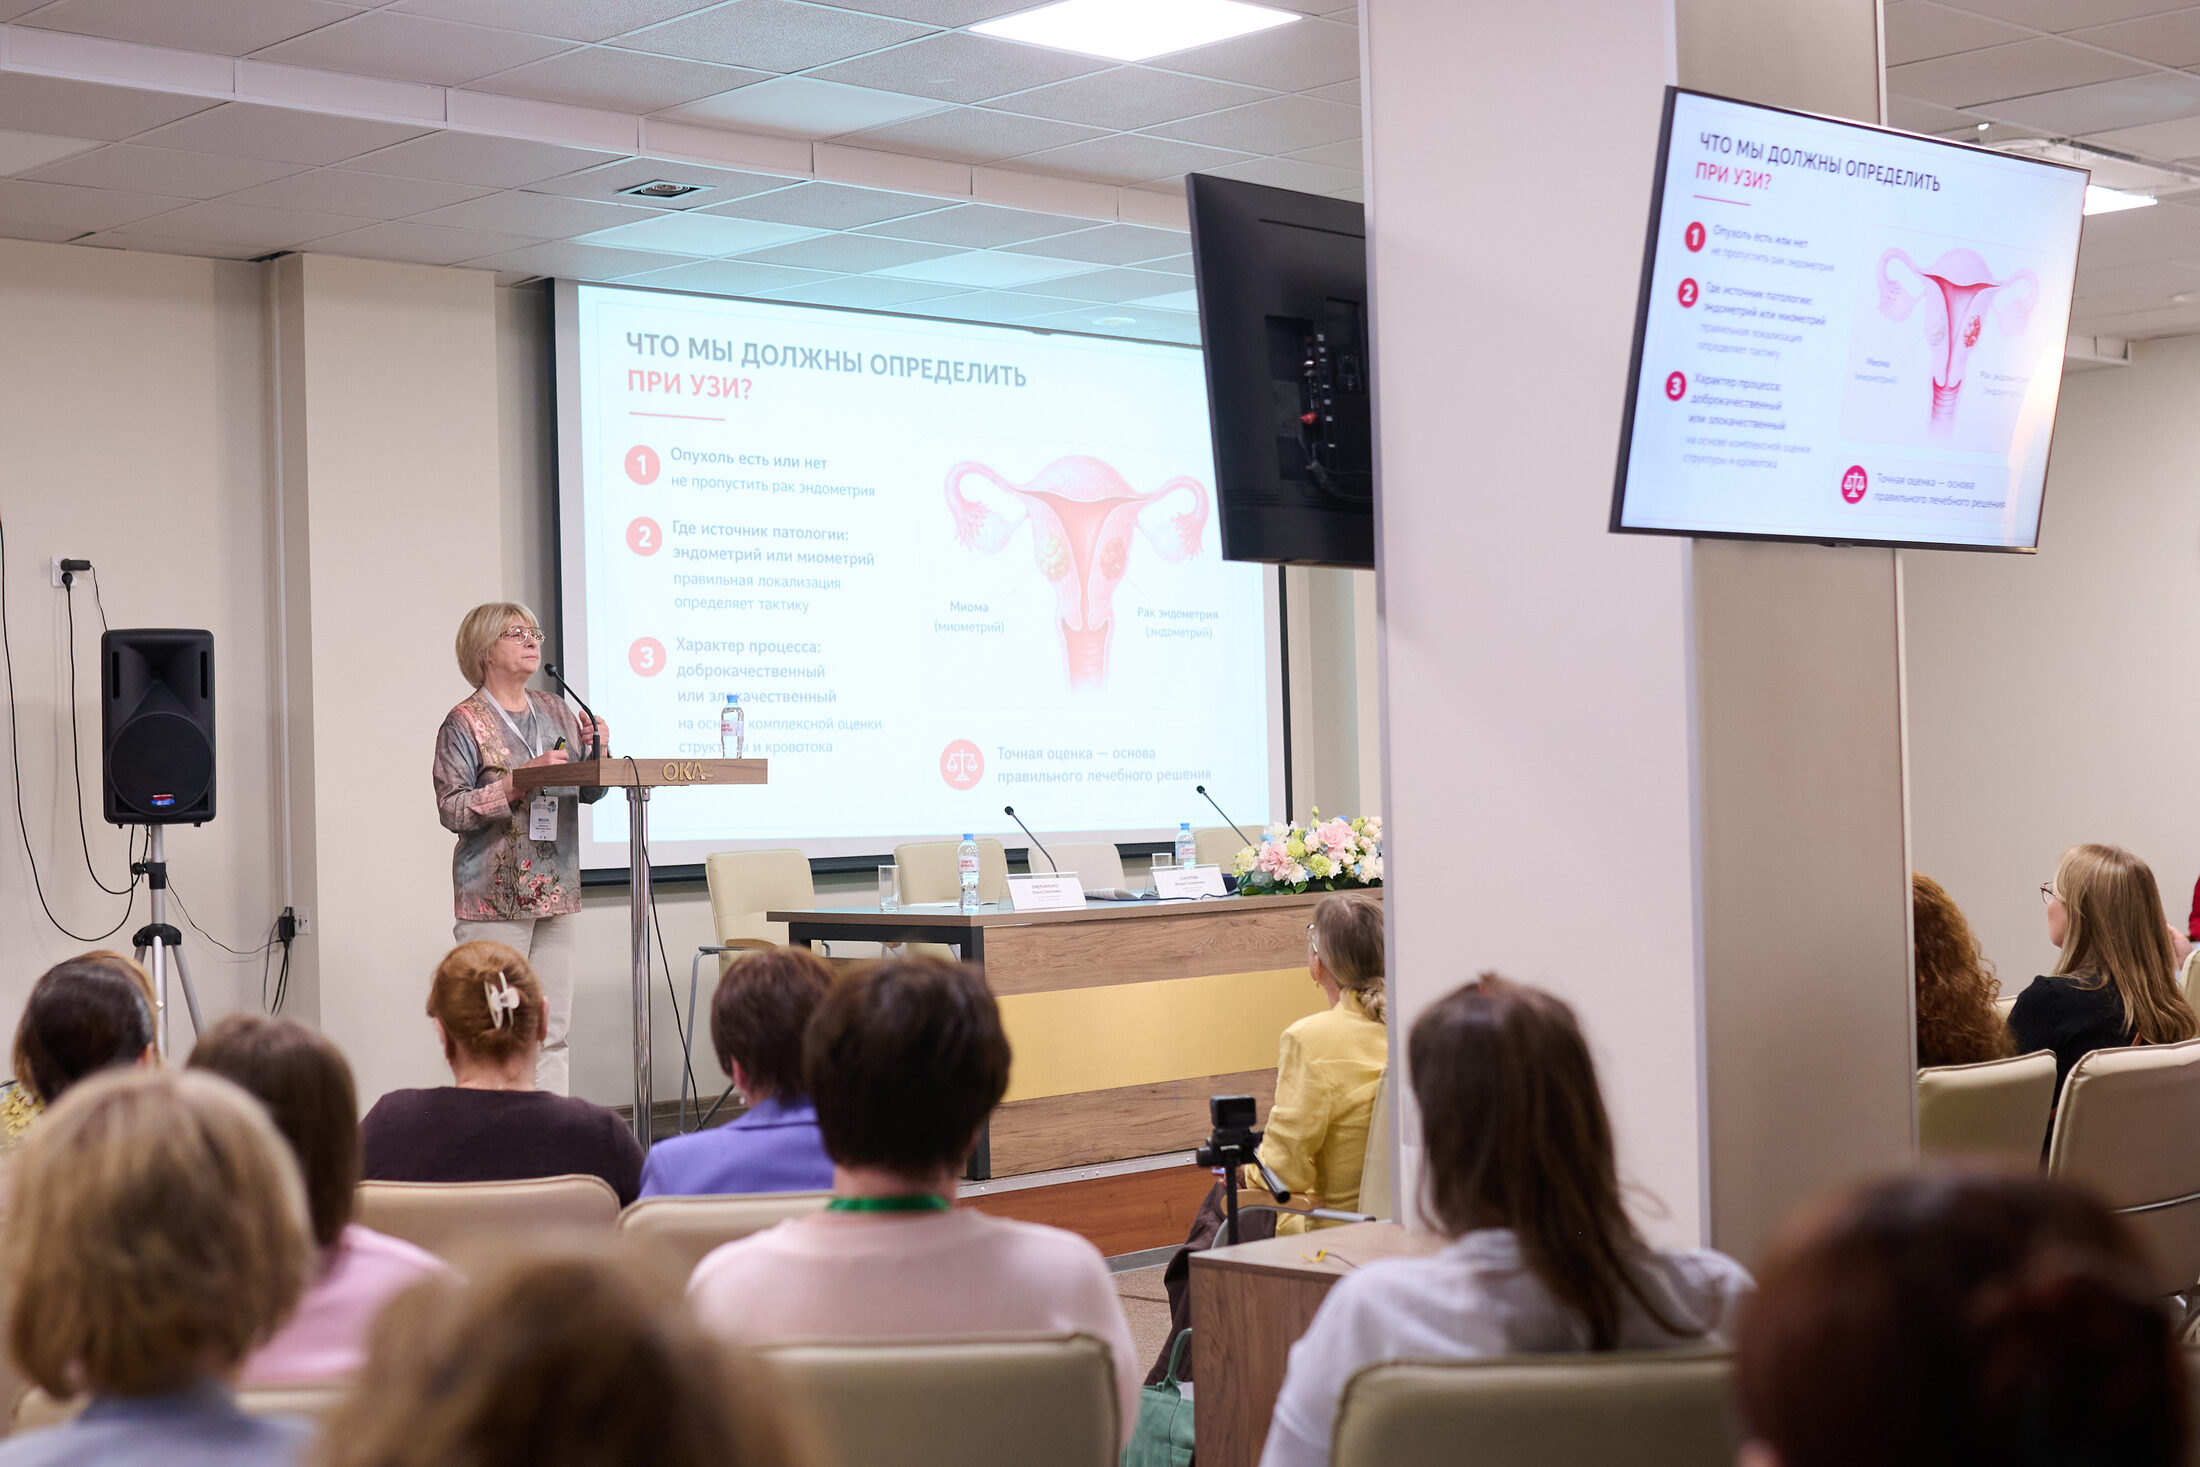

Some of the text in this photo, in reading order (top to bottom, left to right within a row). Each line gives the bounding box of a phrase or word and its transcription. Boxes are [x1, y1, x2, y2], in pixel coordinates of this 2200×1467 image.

[1700, 132, 1941, 192] ЧТО МЫ ДОЛЖНЫ ОПРЕДЕЛИТЬ
[1696, 162, 1772, 191] ПРИ УЗИ?
[1691, 229, 1700, 246] 1
[1682, 283, 1694, 302] 2
[626, 332, 1026, 387] ЧТО МЫ ДОЛЖНЫ ОПРЕДЕЛИТЬ
[628, 369, 752, 399] ПРИ УЗИ?
[1670, 378, 1682, 395] 3
[638, 455, 646, 475] 1
[671, 447, 827, 469] Опухоль есть или нет
[672, 477, 874, 499] не пропустить рак эндометрия
[639, 526, 651, 547] 2
[673, 520, 848, 541] Где источник патологии:
[673, 548, 874, 568] эндометрий или миометрий
[674, 574, 840, 590] правильная локализация
[674, 598, 809, 614] определяет тактику
[950, 600, 988, 612] Миома
[1138, 607, 1218, 622] Рак эндометрия
[934, 619, 1004, 634] (миометрий)
[1146, 625, 1212, 640] (эндометрий)
[676, 637, 820, 656] Характер процесса:
[640, 647, 654, 668] 3
[677, 663, 825, 680] доброкачественный
[678, 689, 837, 705] или злкачественный
[679, 720, 693, 730] на
[697, 718, 735, 730] осн
[749, 717, 834, 730] комплексной
[838, 720, 882, 731] оценки
[678, 741, 832, 756] структы и кровотока
[997, 746, 1042, 760] Точная
[1047, 749, 1093, 761] оценка
[1113, 749, 1155, 759] основа
[998, 768, 1211, 786] правильного лечебного решения
